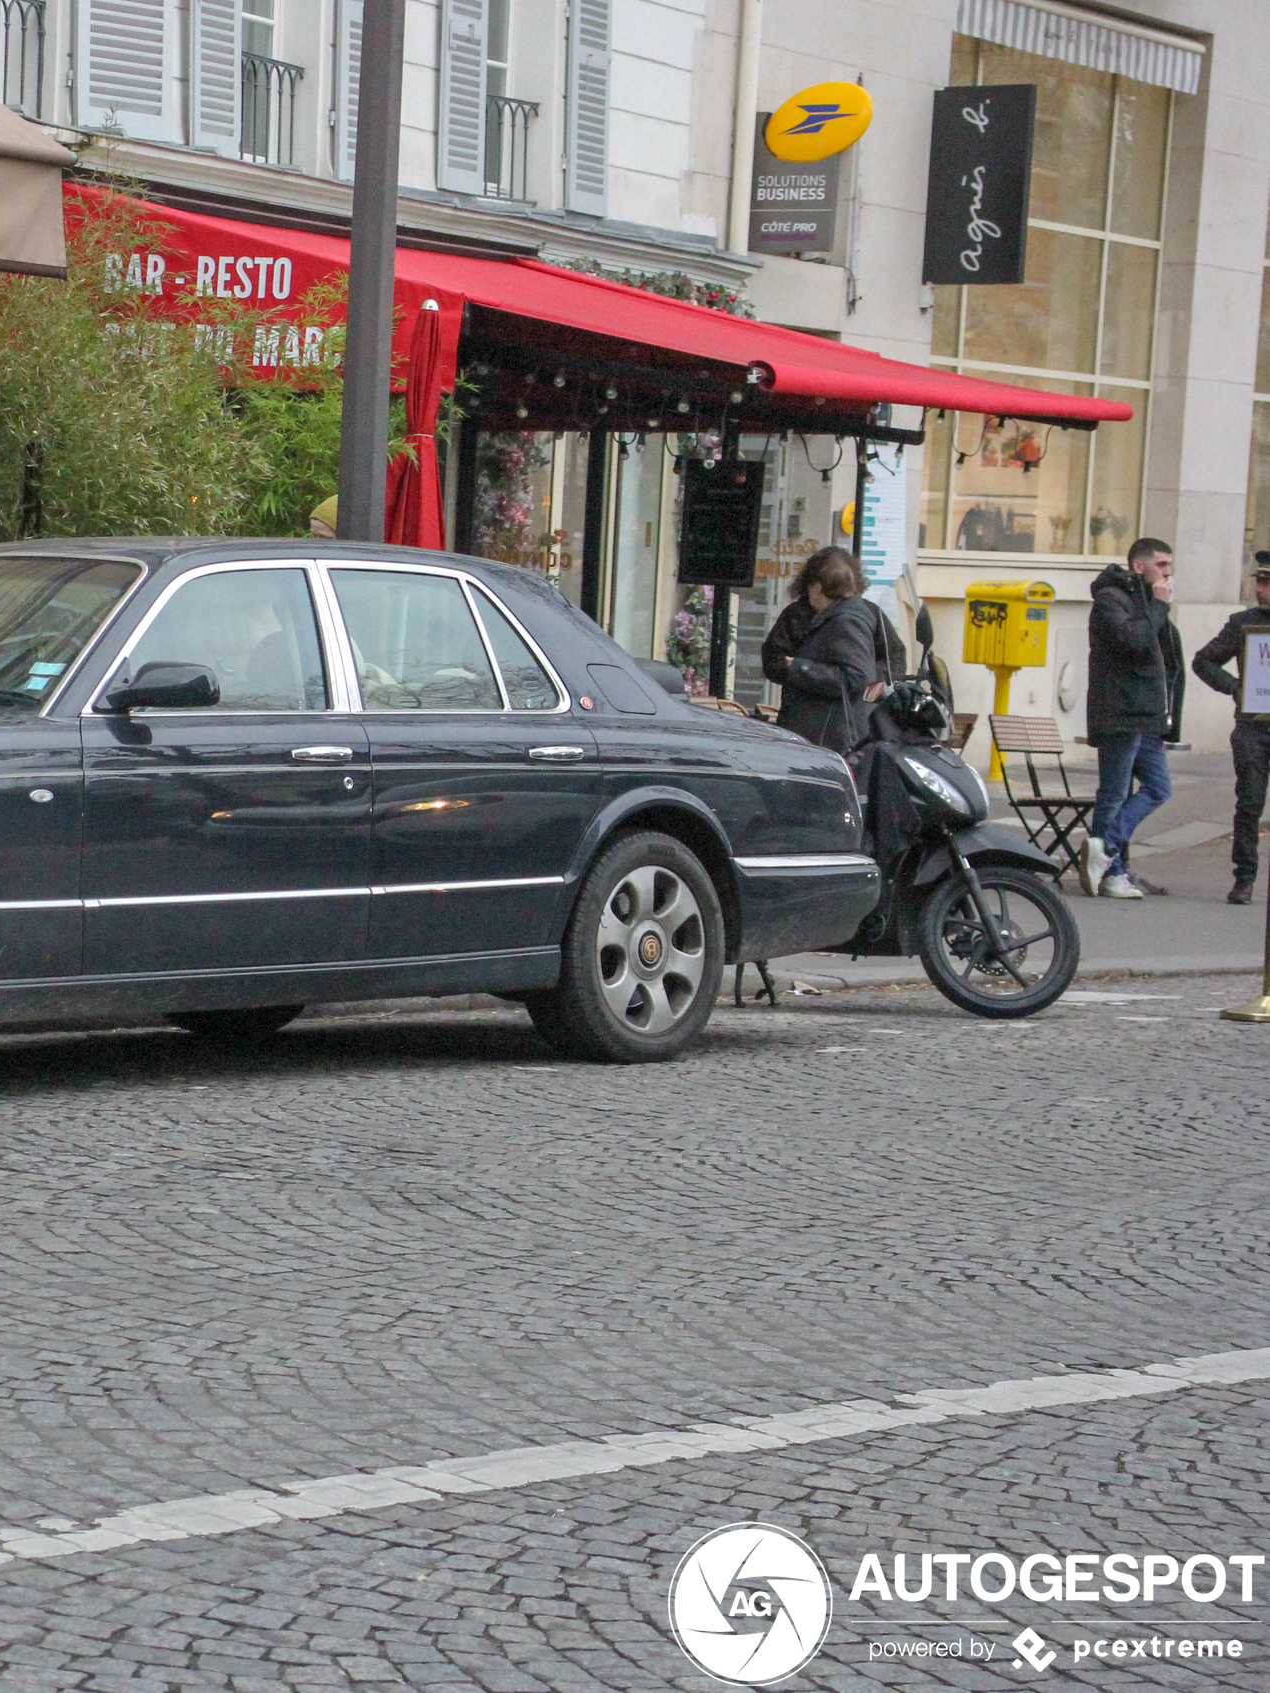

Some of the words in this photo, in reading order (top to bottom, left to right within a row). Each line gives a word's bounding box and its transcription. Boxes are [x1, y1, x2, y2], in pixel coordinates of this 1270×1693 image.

[758, 175, 826, 187] SOLUTIONS
[757, 188, 826, 200] BUSINESS
[960, 165, 1001, 272] agnès
[761, 221, 791, 232] CÔTÉ
[792, 223, 817, 232] PRO
[104, 253, 167, 295] BAR
[197, 256, 292, 299] RESTO
